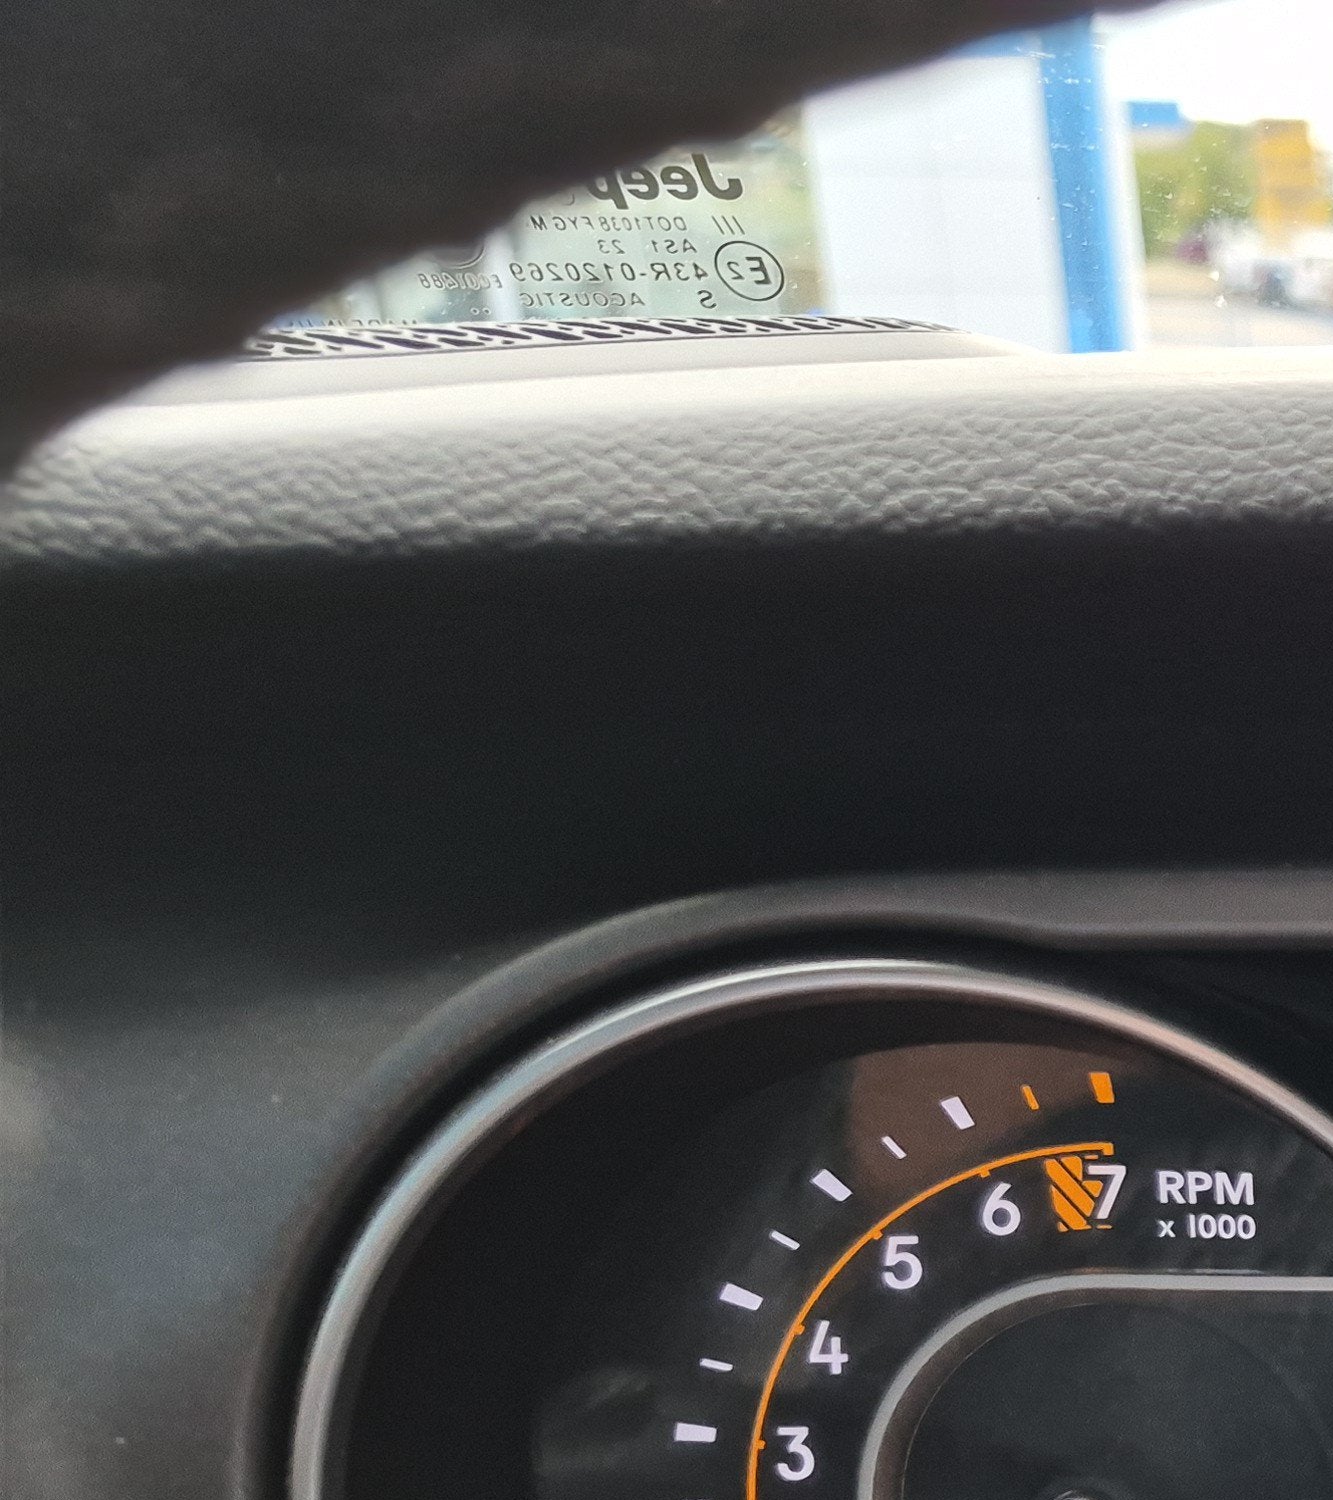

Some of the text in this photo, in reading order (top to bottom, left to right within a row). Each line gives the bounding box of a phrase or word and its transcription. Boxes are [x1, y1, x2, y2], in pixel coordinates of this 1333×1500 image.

[980, 1180, 1022, 1238] 6
[1086, 1163, 1128, 1221] 7
[1156, 1169, 1256, 1207] RPM
[1157, 1212, 1257, 1241] x 1000
[881, 1234, 924, 1292] 5
[806, 1318, 850, 1376] 4
[775, 1425, 816, 1482] 3
